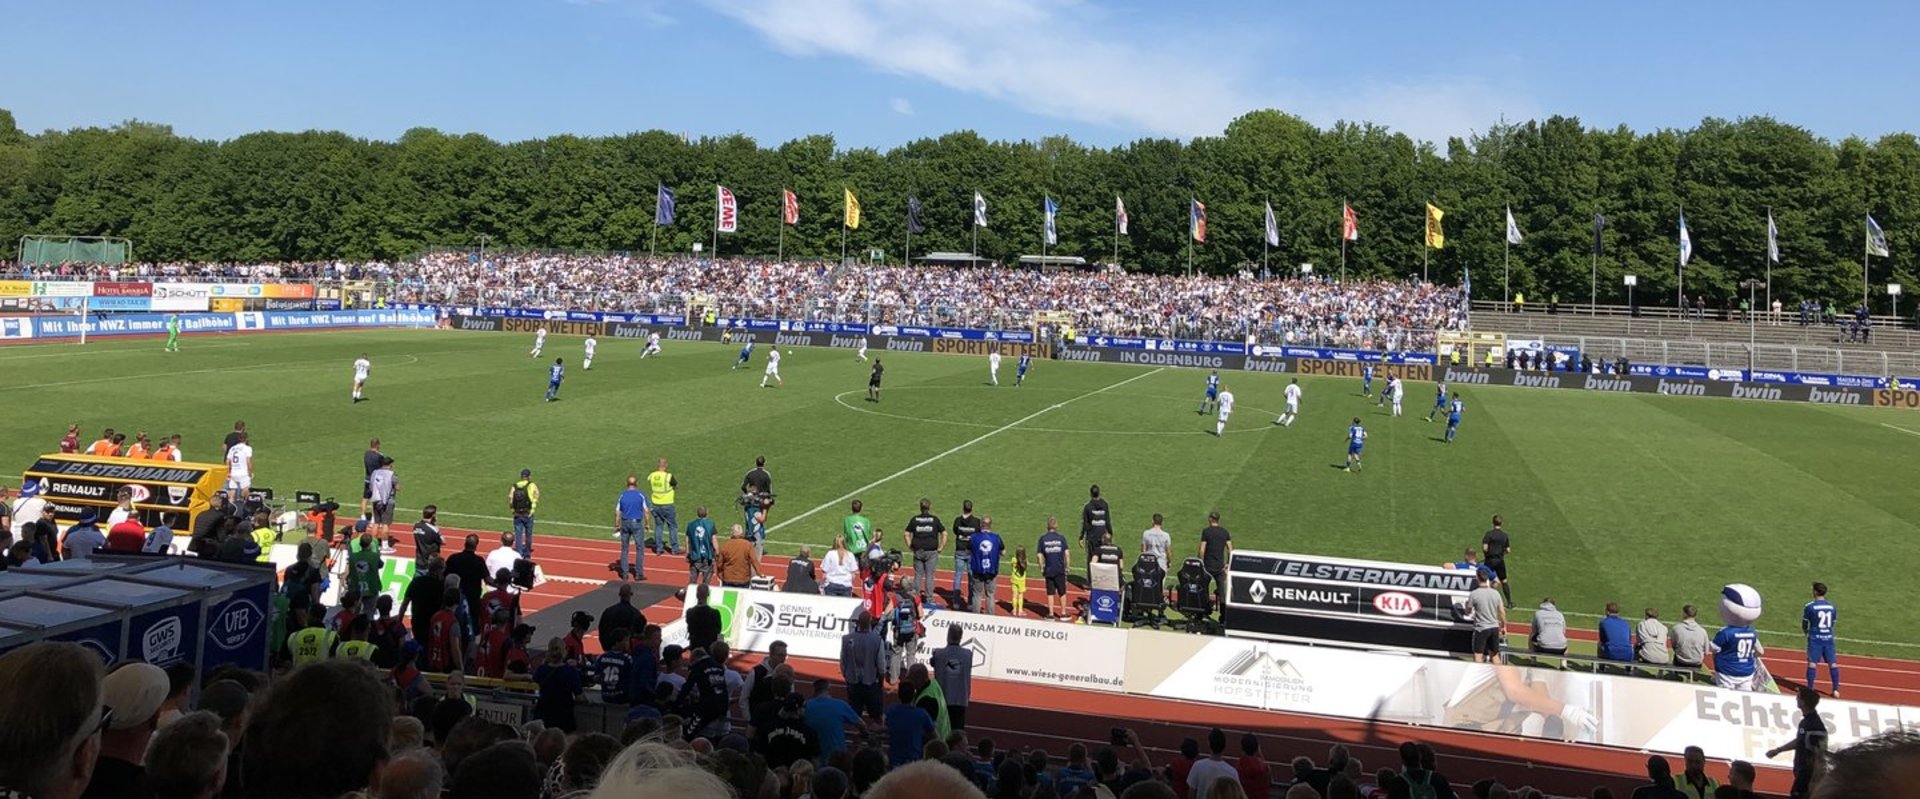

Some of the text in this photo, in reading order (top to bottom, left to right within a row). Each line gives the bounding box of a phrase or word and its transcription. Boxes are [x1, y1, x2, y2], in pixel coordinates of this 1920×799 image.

[43, 320, 63, 333] Mit
[67, 319, 96, 332] Ihrer
[100, 319, 125, 331] NWZ
[128, 318, 162, 330] immer
[271, 311, 435, 325] Mit Ihrer NWZ immer auf Ballhöhe!
[462, 317, 495, 330] bwin
[506, 318, 603, 335] SPORTWETTEN
[614, 324, 649, 337] bwin
[667, 327, 702, 340] bwin
[775, 331, 811, 345] bwin
[886, 337, 924, 351] bwin
[936, 339, 1048, 358] SPORTWETTEN
[1061, 346, 1101, 361] bwin
[1120, 351, 1223, 368] IN OLDENBURG
[1244, 355, 1286, 371] bwin
[1444, 368, 1490, 383] bwin
[1513, 371, 1560, 387] bwin
[1584, 374, 1632, 391] bwin
[1657, 378, 1706, 395] bwin
[1731, 382, 1783, 400] bwin
[1809, 387, 1861, 404] bwin
[233, 451, 239, 463] 6
[64, 463, 197, 482] ELSTERMANN
[52, 482, 106, 497] RENAULT
[1284, 562, 1473, 590] ELSTERMANN
[1272, 587, 1414, 611] RENAULT KIA
[780, 604, 812, 614] DENNIS
[1818, 610, 1832, 628] 21
[149, 624, 174, 646] GWS
[997, 625, 1021, 636] ZUM
[1024, 628, 1068, 641] ERFOLG!
[1737, 638, 1753, 658] 97
[1006, 667, 1123, 686] www.wiese-generalbau.de
[1214, 676, 1313, 692] MODERNISIERUNG
[1214, 685, 1311, 703] HOFSTETTER
[1695, 690, 1837, 735] Echts
